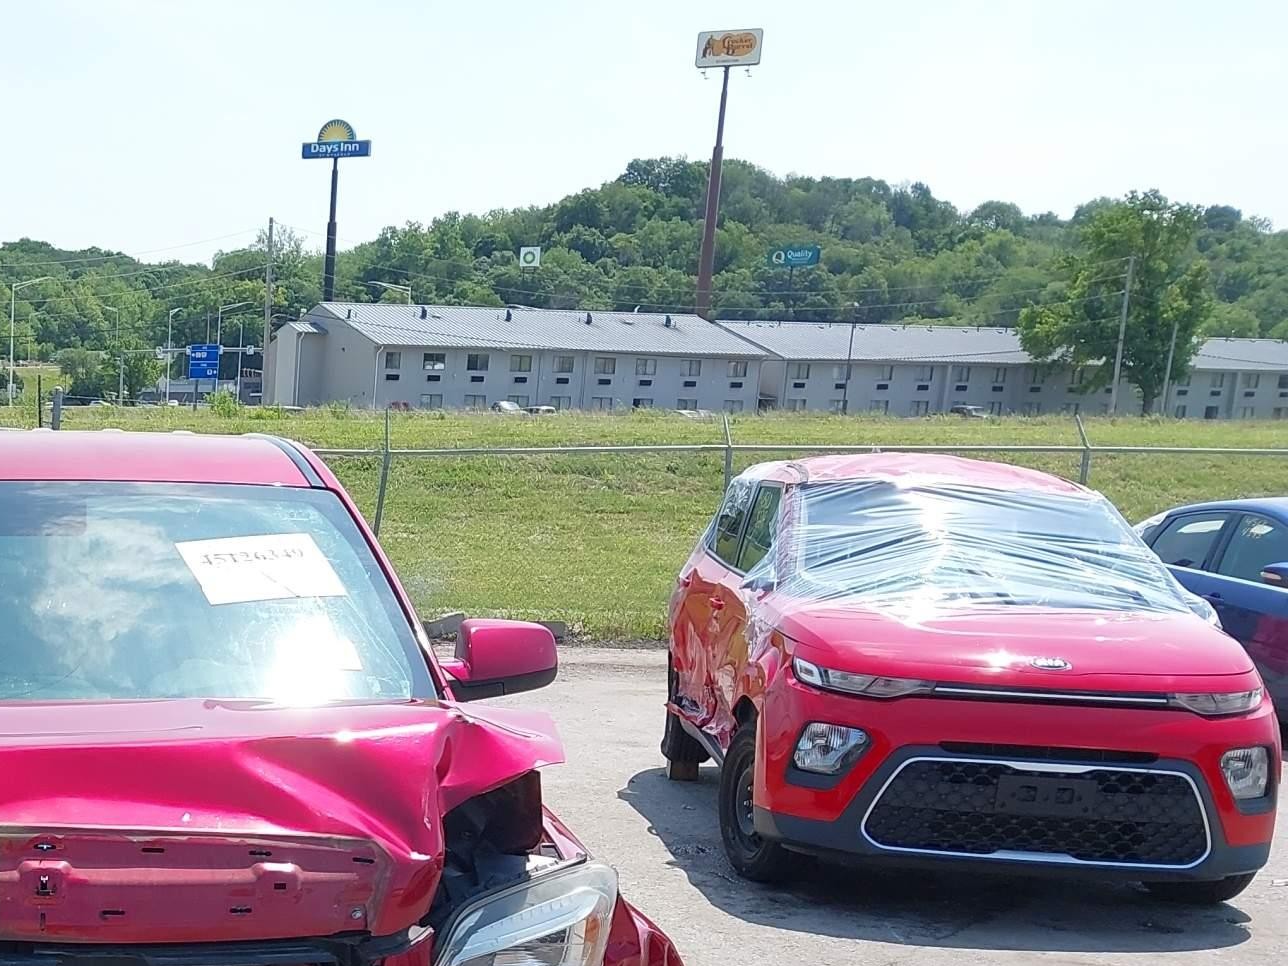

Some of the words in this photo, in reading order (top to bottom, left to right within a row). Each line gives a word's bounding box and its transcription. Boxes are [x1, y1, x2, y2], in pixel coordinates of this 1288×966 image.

[310, 143, 339, 154] Days
[340, 142, 360, 152] Inn
[787, 249, 813, 260] Quality
